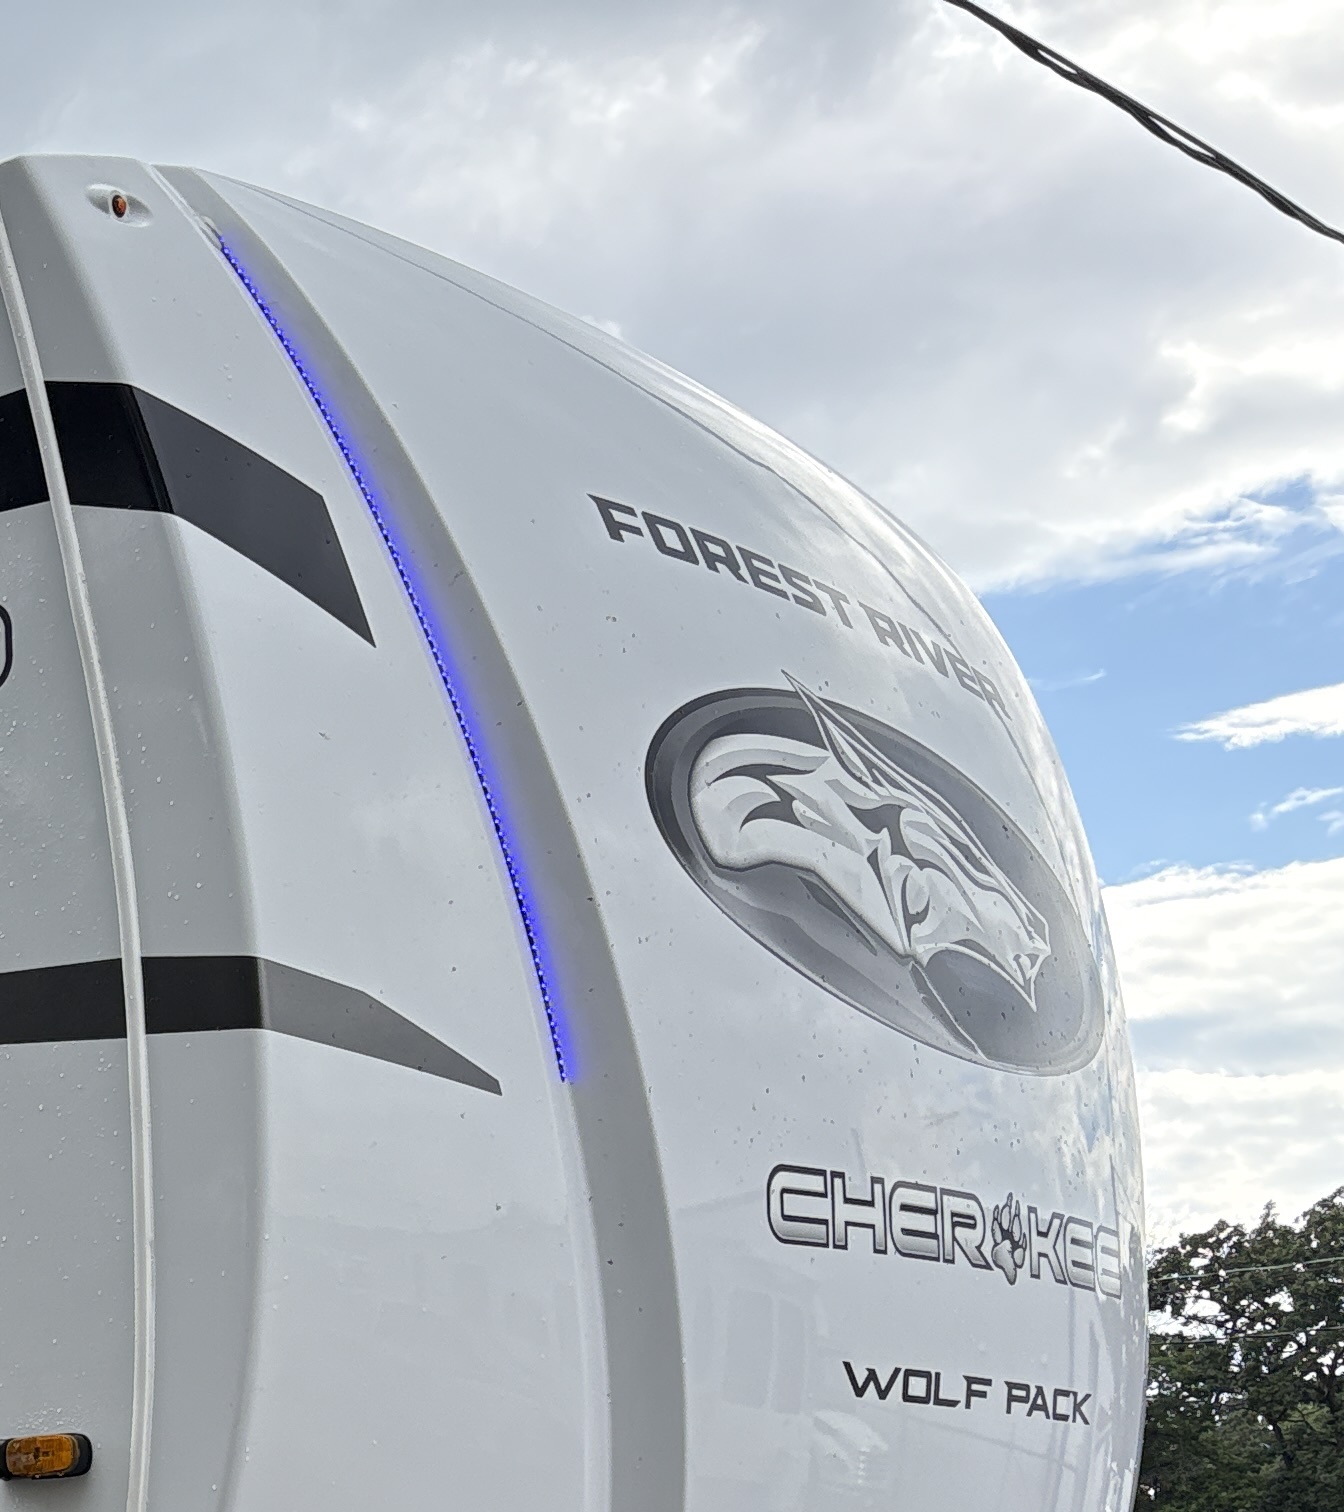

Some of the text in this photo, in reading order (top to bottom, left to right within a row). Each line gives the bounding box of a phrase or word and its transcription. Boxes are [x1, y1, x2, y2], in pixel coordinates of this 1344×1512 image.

[586, 493, 1013, 721] FOREST RIVER
[842, 1360, 1092, 1426] WOLF PACK
